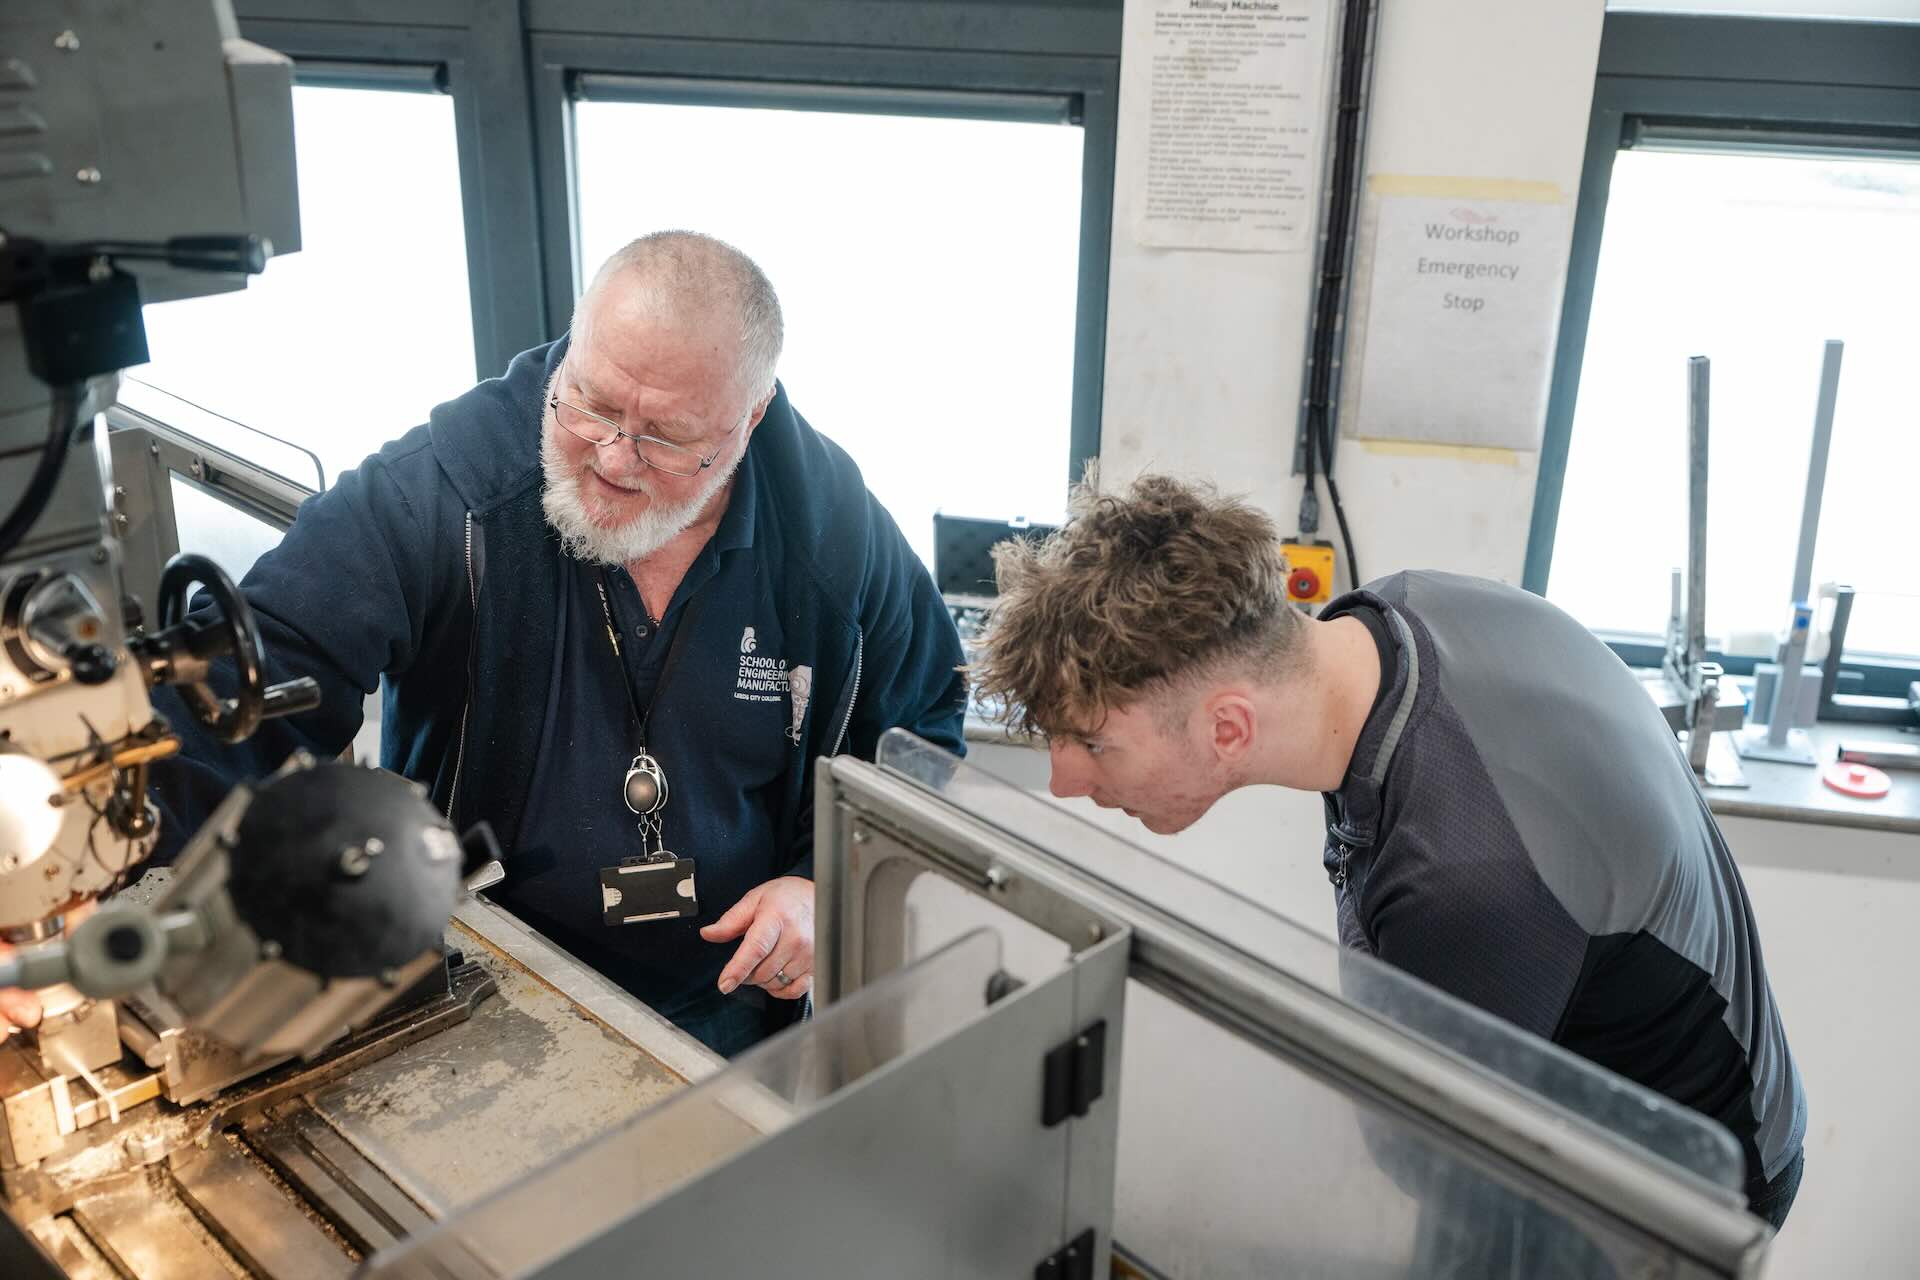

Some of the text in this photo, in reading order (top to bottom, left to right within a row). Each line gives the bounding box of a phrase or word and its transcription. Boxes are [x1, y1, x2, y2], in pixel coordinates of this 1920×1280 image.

[1189, 0, 1279, 11] Milling Machine
[1425, 223, 1520, 246] Workshop
[1417, 257, 1520, 281] Emergency
[1442, 292, 1485, 313] Stop
[740, 655, 786, 669] SCHOOL O
[739, 667, 788, 680] ENGINEERI
[737, 678, 790, 692] MANUFACTU
